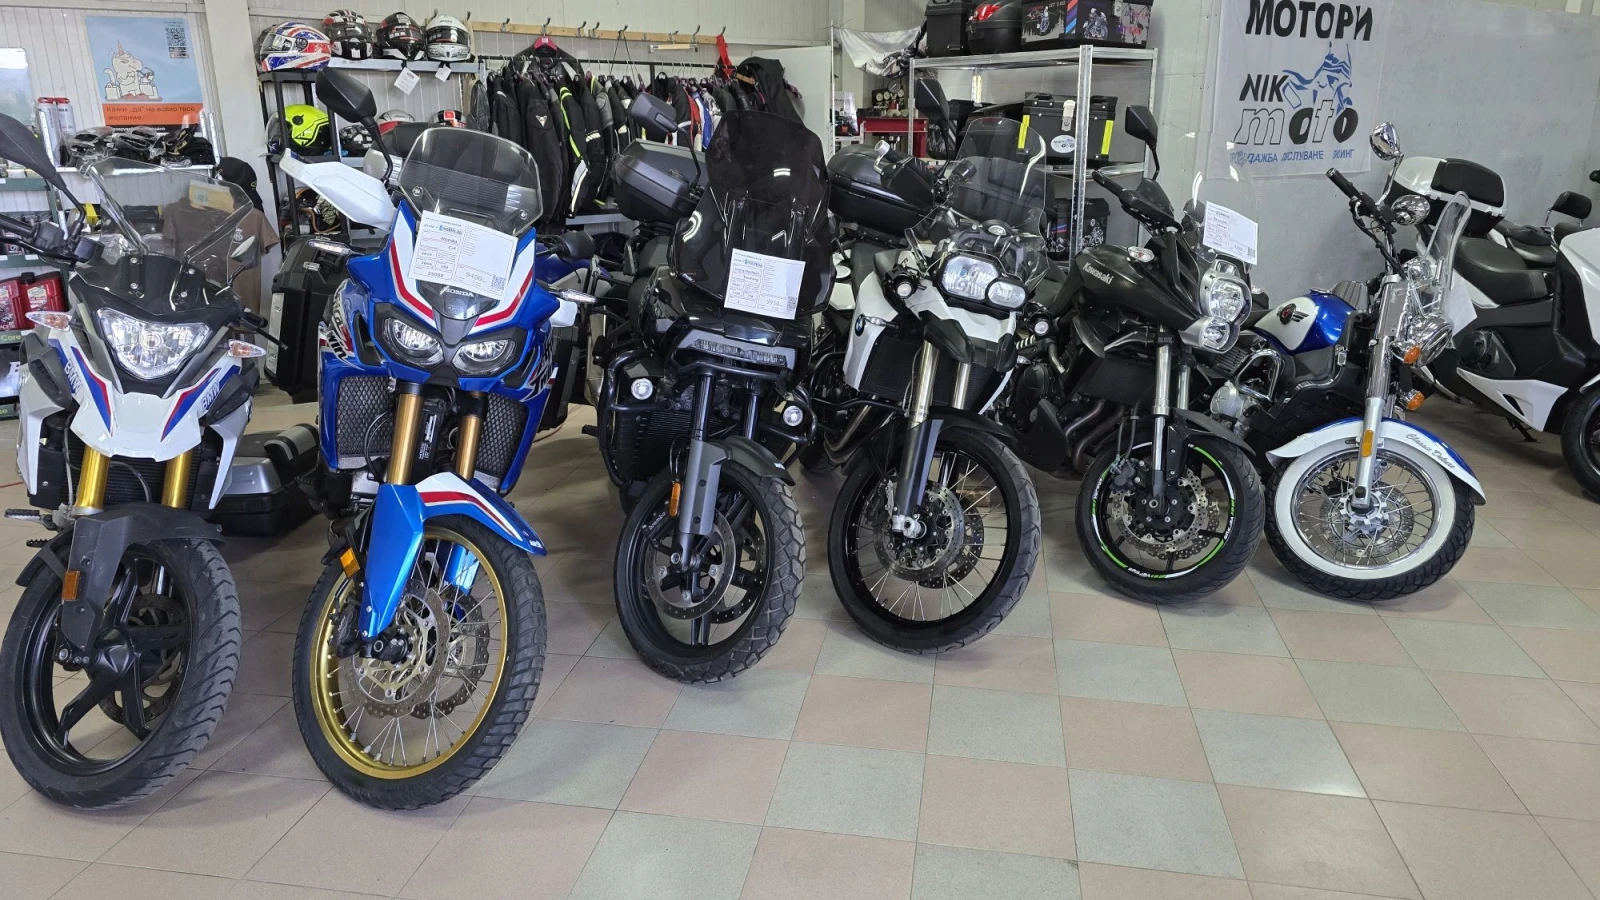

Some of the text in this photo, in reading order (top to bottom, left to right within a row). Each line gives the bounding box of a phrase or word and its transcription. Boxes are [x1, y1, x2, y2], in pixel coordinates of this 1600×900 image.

[1245, 0, 1373, 41] МОТОРИ
[1239, 73, 1289, 102] NIK
[1234, 99, 1358, 145] moto
[1082, 261, 1114, 284] Kawasaki
[64, 359, 83, 395] BMW
[201, 379, 220, 411] BMW
